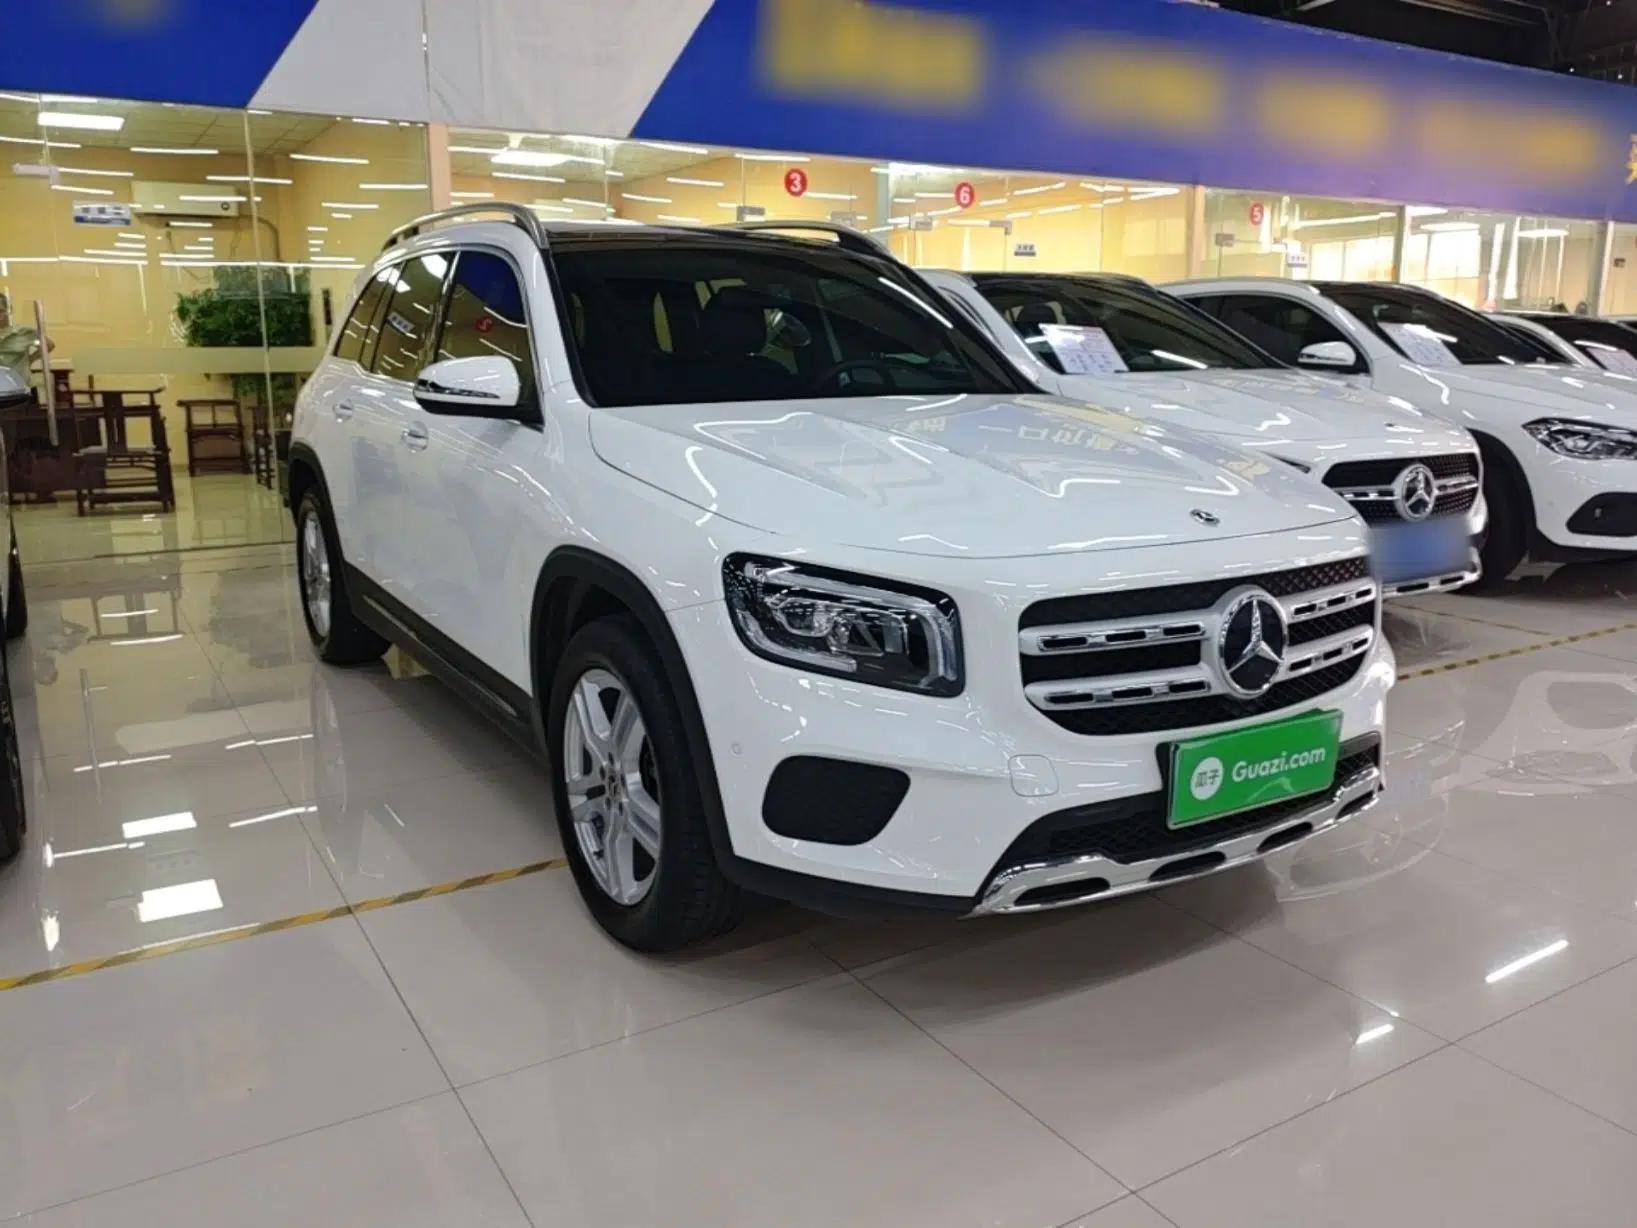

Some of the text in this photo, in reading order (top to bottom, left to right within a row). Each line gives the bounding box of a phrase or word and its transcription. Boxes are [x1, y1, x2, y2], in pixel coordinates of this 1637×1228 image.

[789, 172, 802, 192] 3
[960, 184, 971, 205] 6
[1252, 205, 1262, 223] 5
[1232, 748, 1326, 782] Guazi.com
[1196, 769, 1220, 788] 瓜子
